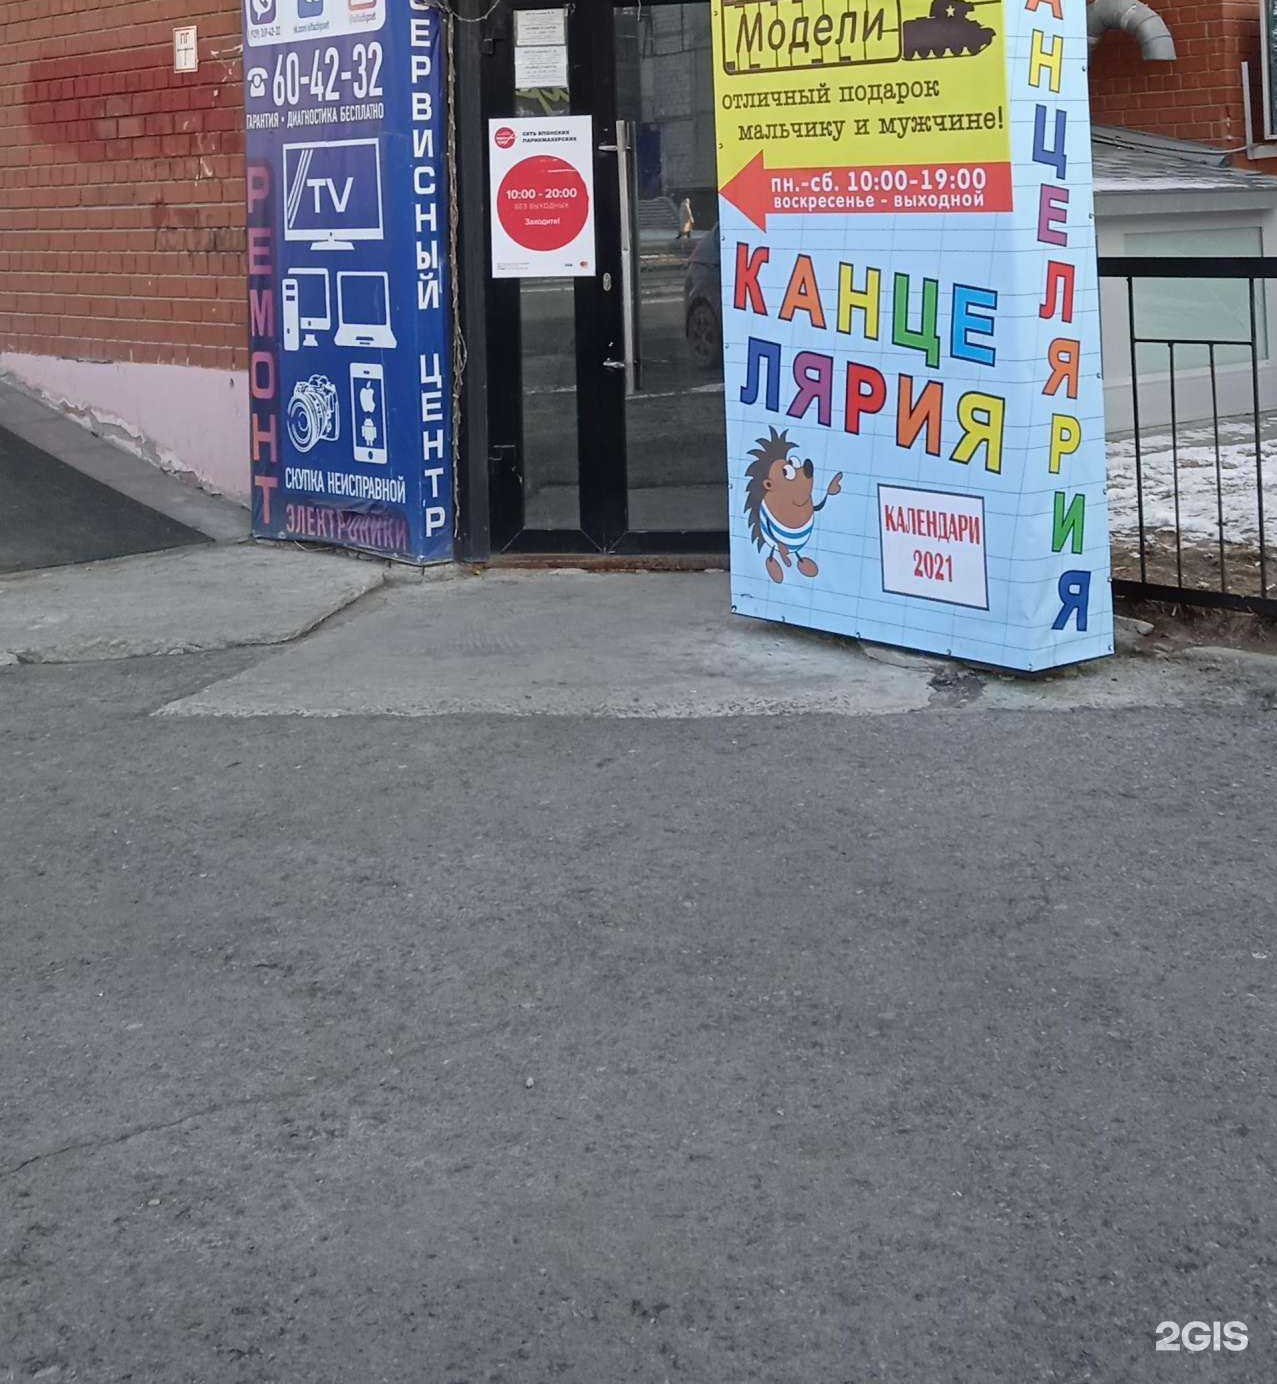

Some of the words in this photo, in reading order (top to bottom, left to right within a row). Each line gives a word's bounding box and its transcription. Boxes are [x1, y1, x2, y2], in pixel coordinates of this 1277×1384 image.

[736, 7, 885, 54] Модели
[273, 41, 383, 107] 60-42-32
[722, 83, 830, 110] отличный
[838, 79, 940, 104] подарок
[246, 112, 279, 130] ГАРАНТИЯ
[287, 106, 338, 129] ДИАГНОСТИКА
[340, 102, 384, 122] БЕСПЛАТНО
[738, 117, 846, 142] мальчику
[855, 117, 870, 135] и
[878, 106, 1005, 139] мужчине!
[306, 176, 354, 214] TV
[506, 188, 536, 200] 10:00
[545, 187, 577, 198] 20:00
[771, 170, 839, 193] пн.-сб.
[848, 168, 987, 191] 10:00-19:00
[774, 193, 875, 209] воскресенье
[894, 192, 985, 209] выходной
[733, 242, 998, 369] КАНЦЕ
[246, 165, 279, 526] РЕМОНТ
[740, 336, 1005, 475] ЛЯРИЯ
[420, 353, 446, 538] ЦЕНТР
[285, 467, 325, 493] СКУПКА
[327, 472, 406, 504] НЕИСПРАВНОЙ
[286, 504, 407, 551] ЭЛЕКТРОНИКИ
[884, 505, 981, 545] КАЛЕНДАРИ
[913, 551, 953, 582] 2021
